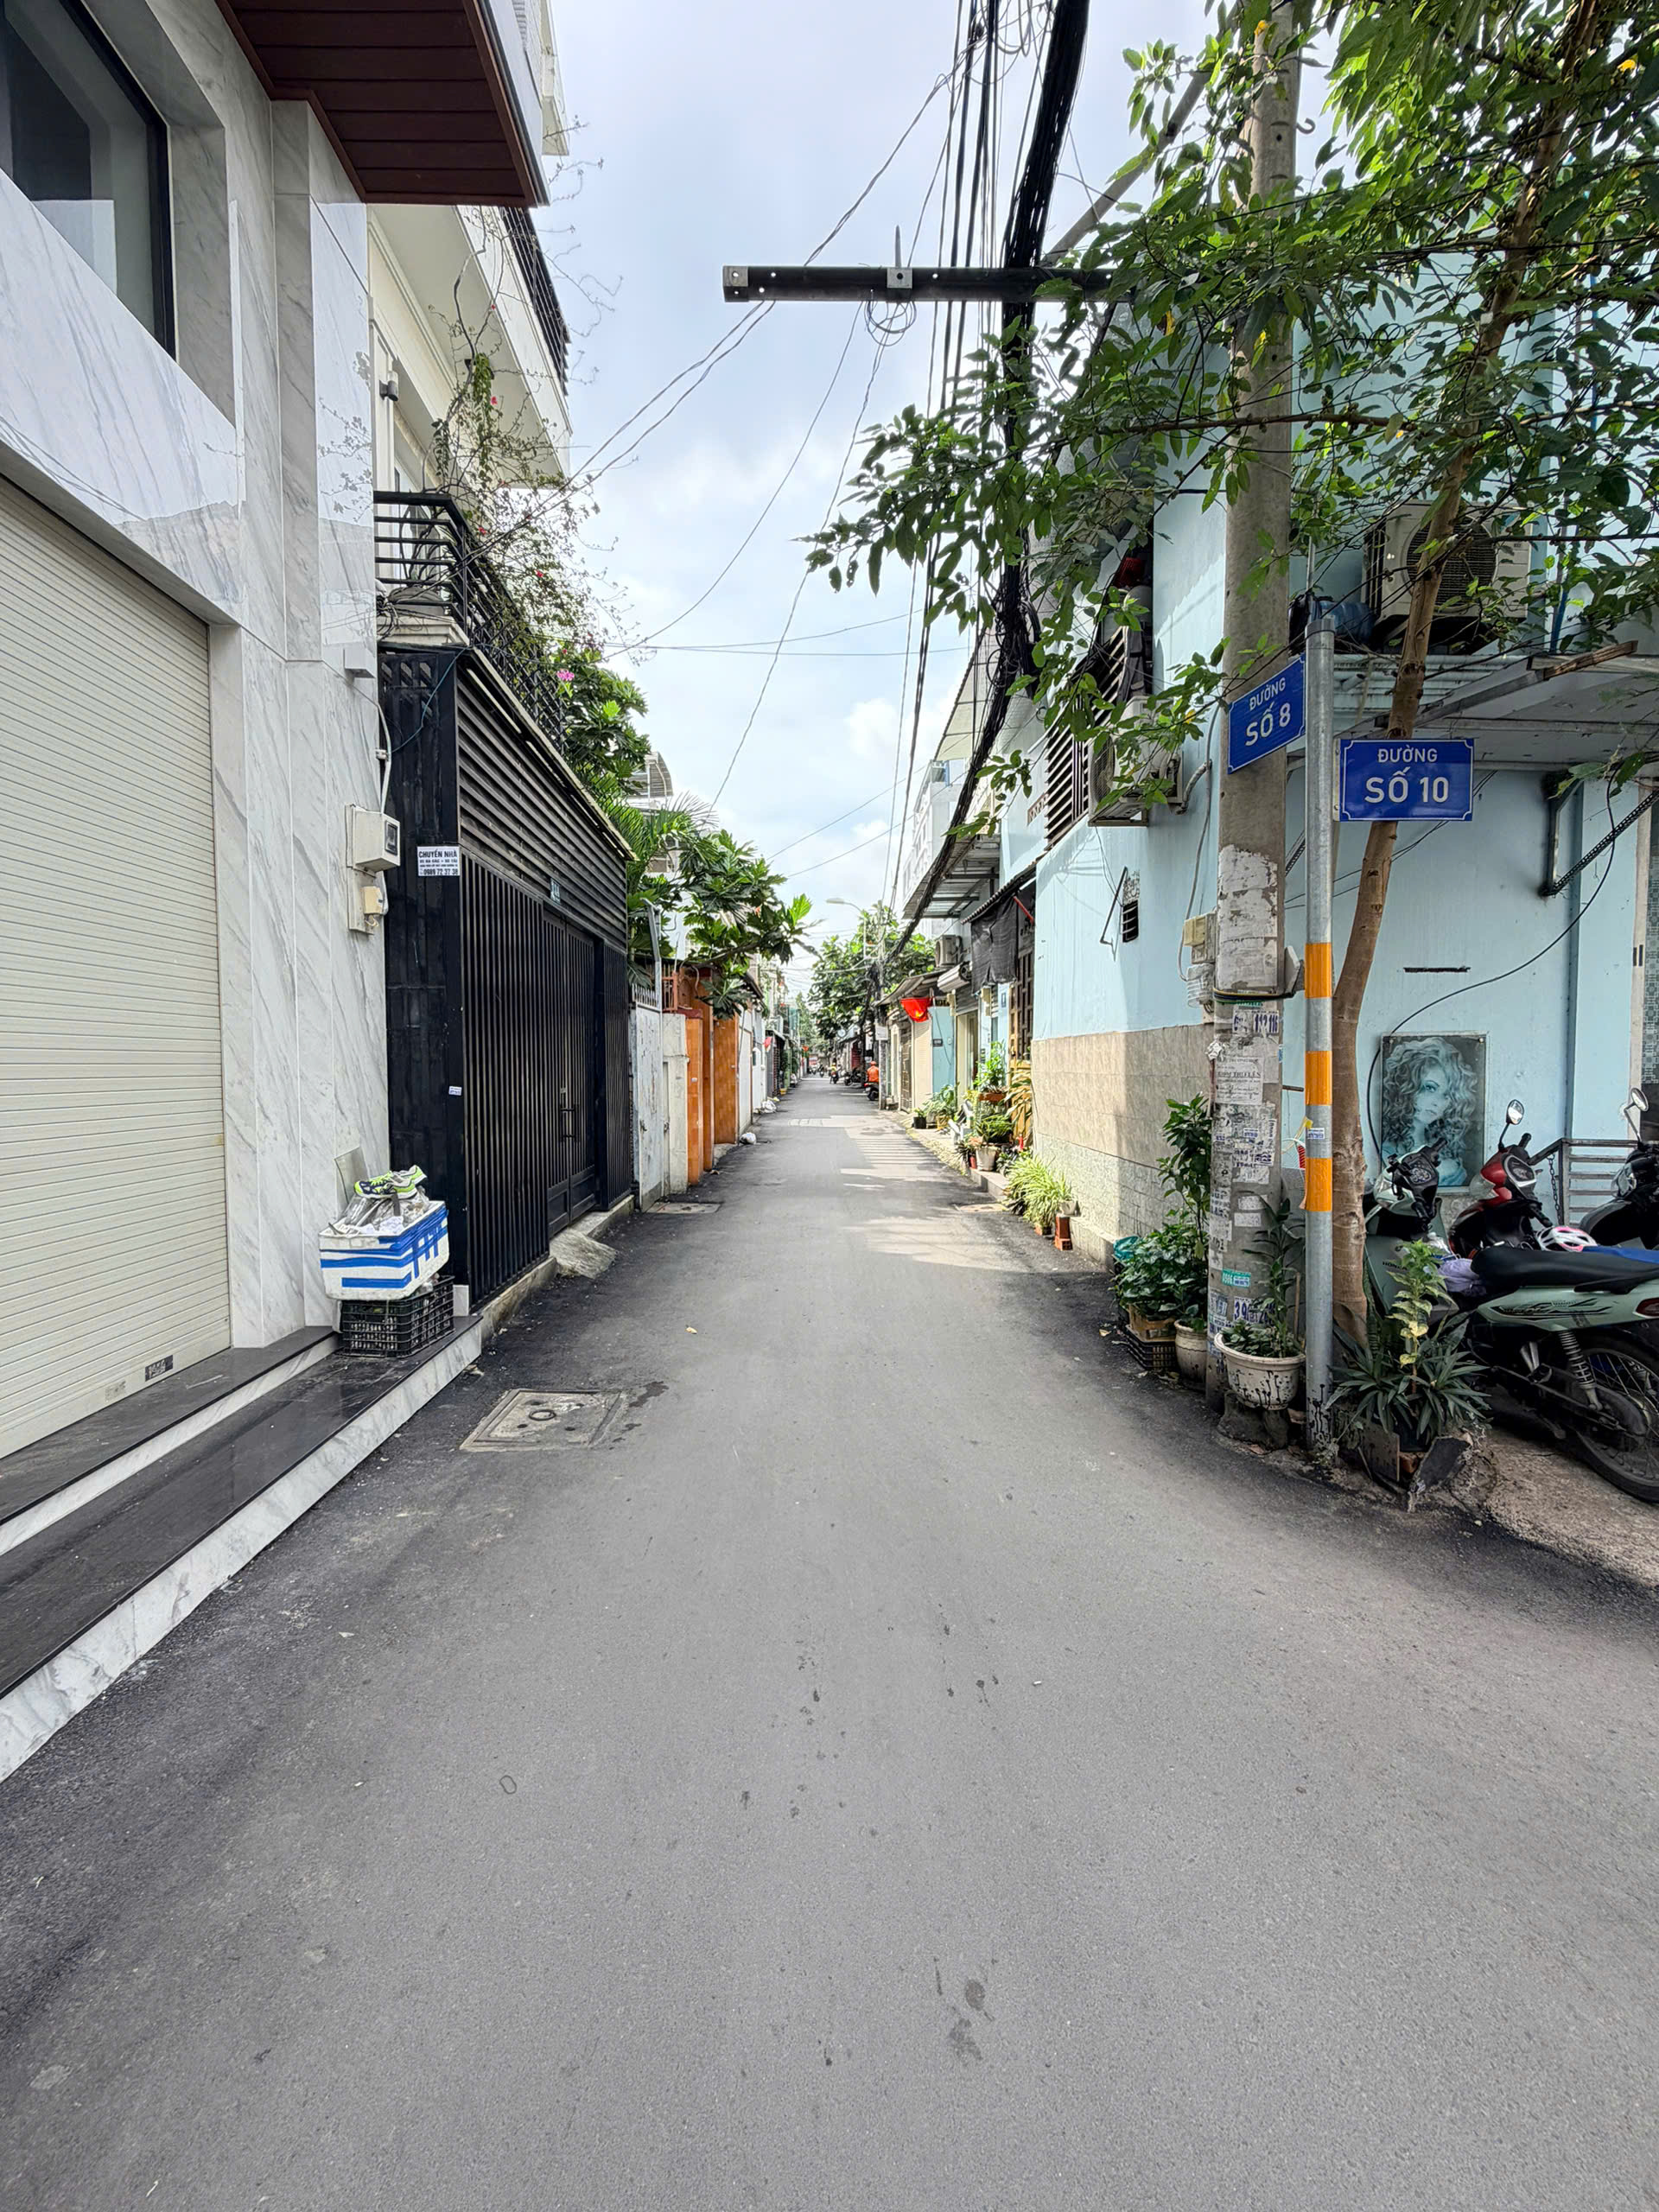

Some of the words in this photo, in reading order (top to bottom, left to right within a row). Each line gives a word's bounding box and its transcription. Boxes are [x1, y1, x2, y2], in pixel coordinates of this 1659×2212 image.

[1249, 677, 1286, 711] ĐƯỜNG
[1245, 702, 1274, 747] SỐ
[1279, 702, 1291, 728] 8
[1377, 744, 1437, 763] ĐƯỜNG
[1364, 766, 1410, 804] SỐ
[1420, 776, 1449, 804] 10
